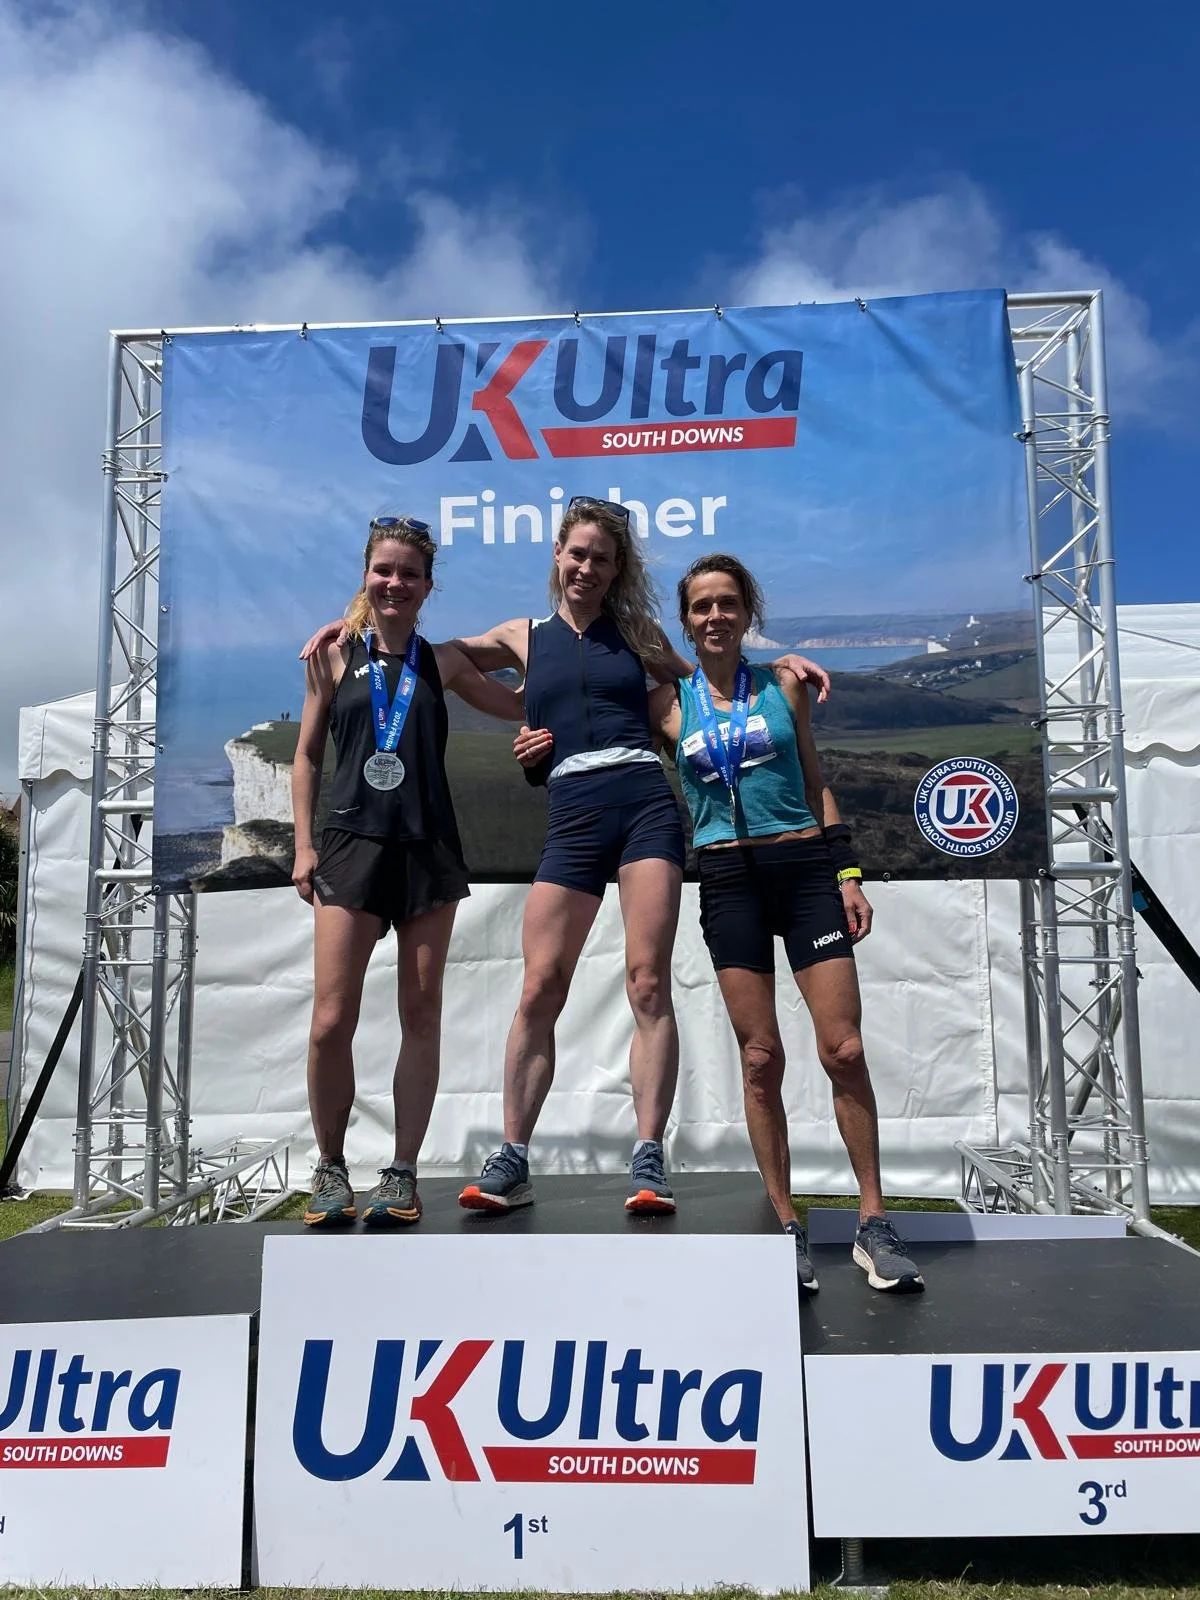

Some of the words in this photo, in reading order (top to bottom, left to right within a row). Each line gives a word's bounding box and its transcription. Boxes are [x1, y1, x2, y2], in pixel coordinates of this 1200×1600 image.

[361, 340, 550, 465] UK
[553, 334, 803, 422] Ultra
[601, 429, 667, 449] SOUTH
[671, 426, 744, 446] DOWNS
[440, 487, 727, 546] Finiher
[918, 788, 930, 804] UK
[924, 765, 951, 788] ULTRA
[950, 760, 987, 772] SOUTH
[986, 767, 1014, 802] DOWNS
[936, 788, 992, 825] UK
[1004, 810, 1015, 826] UK
[919, 812, 946, 846] DOWNS
[981, 825, 1009, 849] ULTRA
[945, 842, 982, 854] SOUTH
[813, 930, 844, 950] HOKA
[292, 1339, 495, 1482] UK
[497, 1340, 763, 1442] Ultra
[929, 1363, 1068, 1462] UK
[2, 1446, 57, 1462] SOUTH
[60, 1445, 123, 1462] DOWNS
[1114, 1440, 1163, 1454] SOUTH
[1165, 1438, 1200, 1453] DOW
[547, 1456, 617, 1476] SOUTH
[622, 1456, 700, 1476] DOWNS
[1077, 1479, 1128, 1526] 3rd
[503, 1513, 549, 1560] 1st
